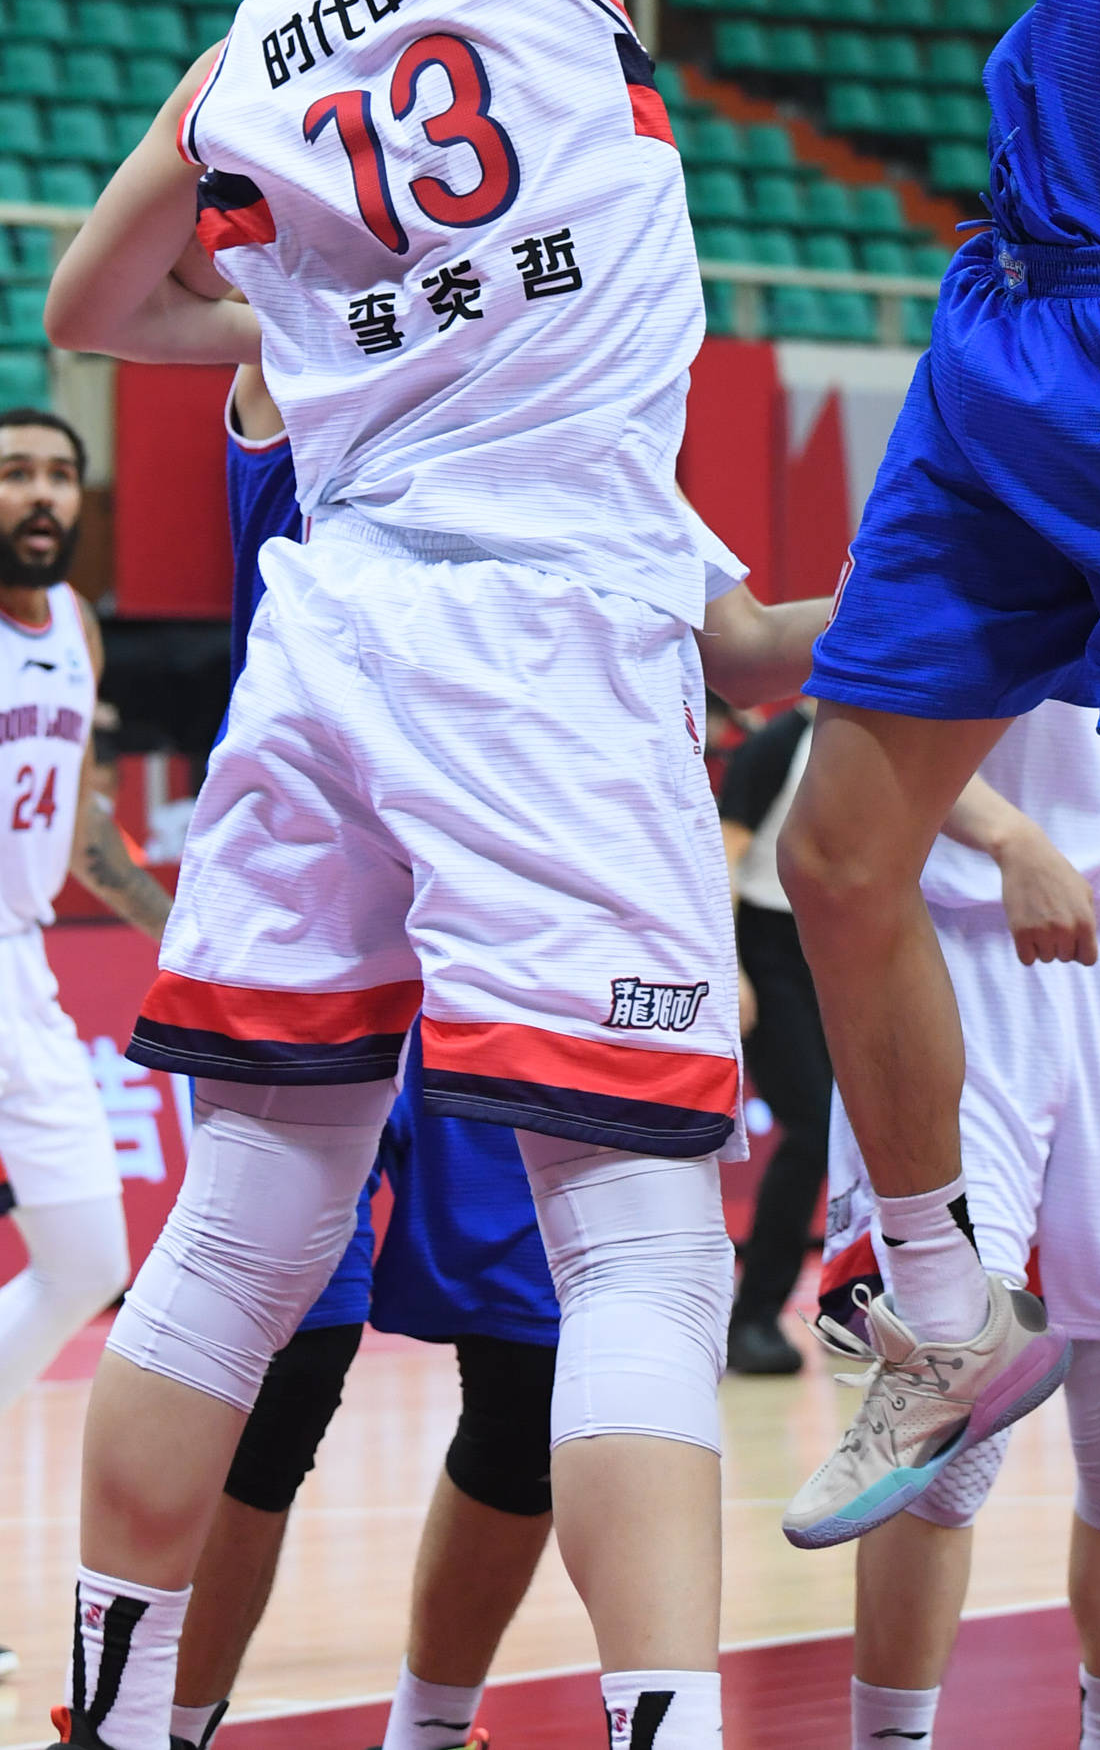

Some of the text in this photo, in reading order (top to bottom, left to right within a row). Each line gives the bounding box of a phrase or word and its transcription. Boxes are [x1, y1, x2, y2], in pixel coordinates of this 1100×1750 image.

[303, 33, 521, 256] 13
[348, 228, 583, 355] 李炎哲
[12, 765, 57, 831] 24
